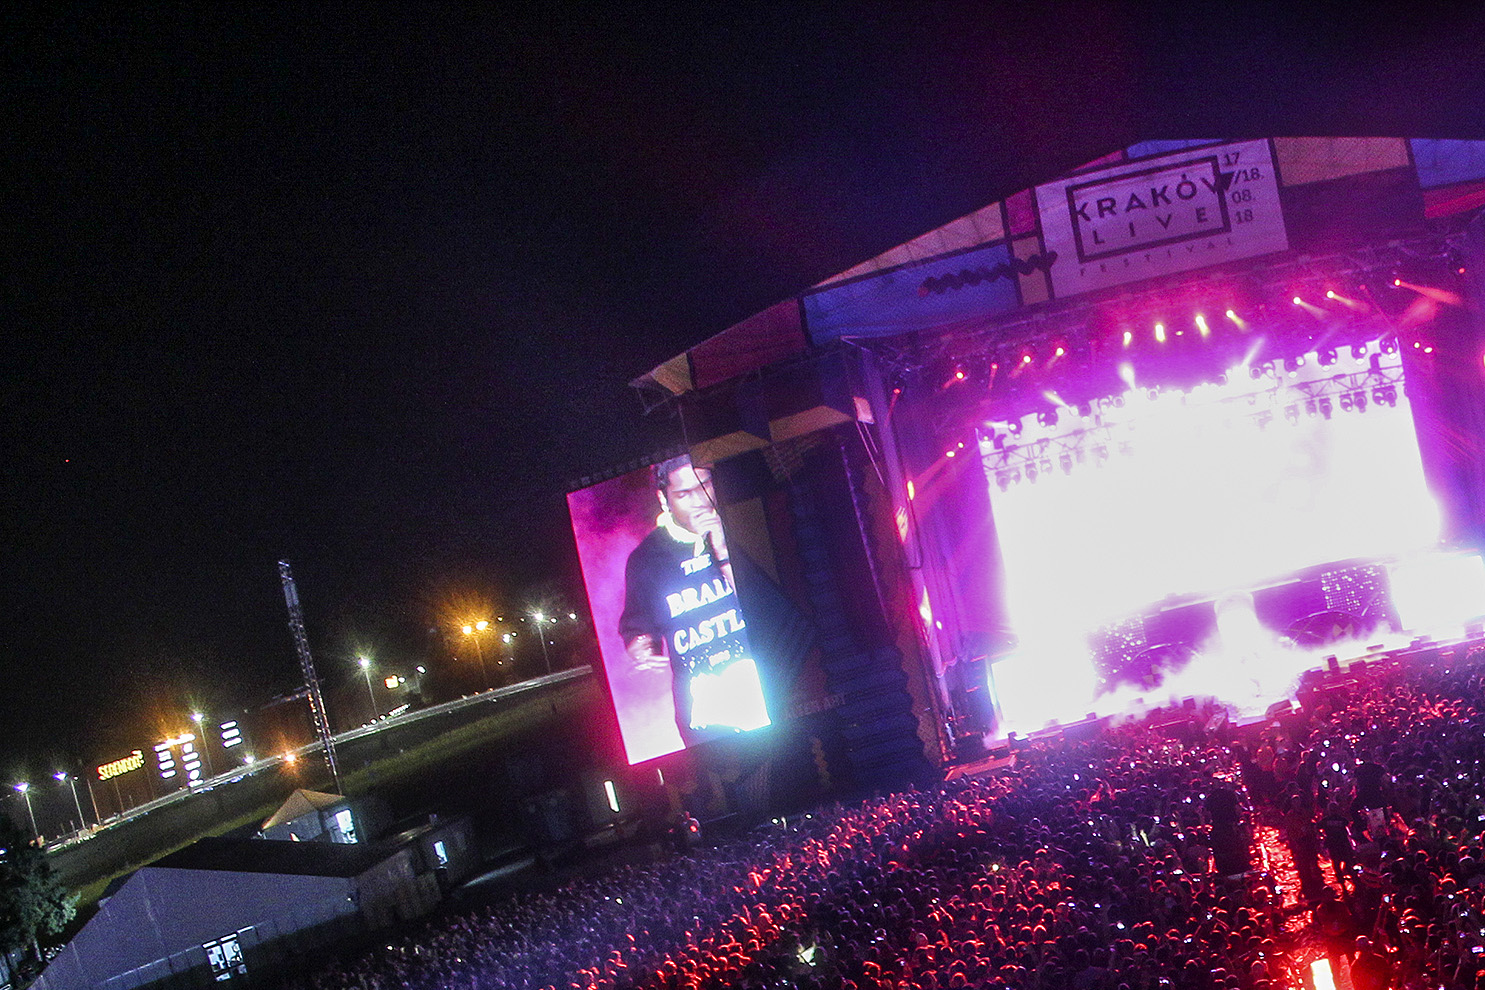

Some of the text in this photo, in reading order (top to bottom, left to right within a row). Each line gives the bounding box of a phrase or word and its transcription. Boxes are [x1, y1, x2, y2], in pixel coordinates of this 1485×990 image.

[1224, 152, 1240, 166] 17
[1092, 207, 1208, 245] LIVE
[1235, 209, 1253, 224] 18
[1079, 237, 1232, 277] FESTIVAL
